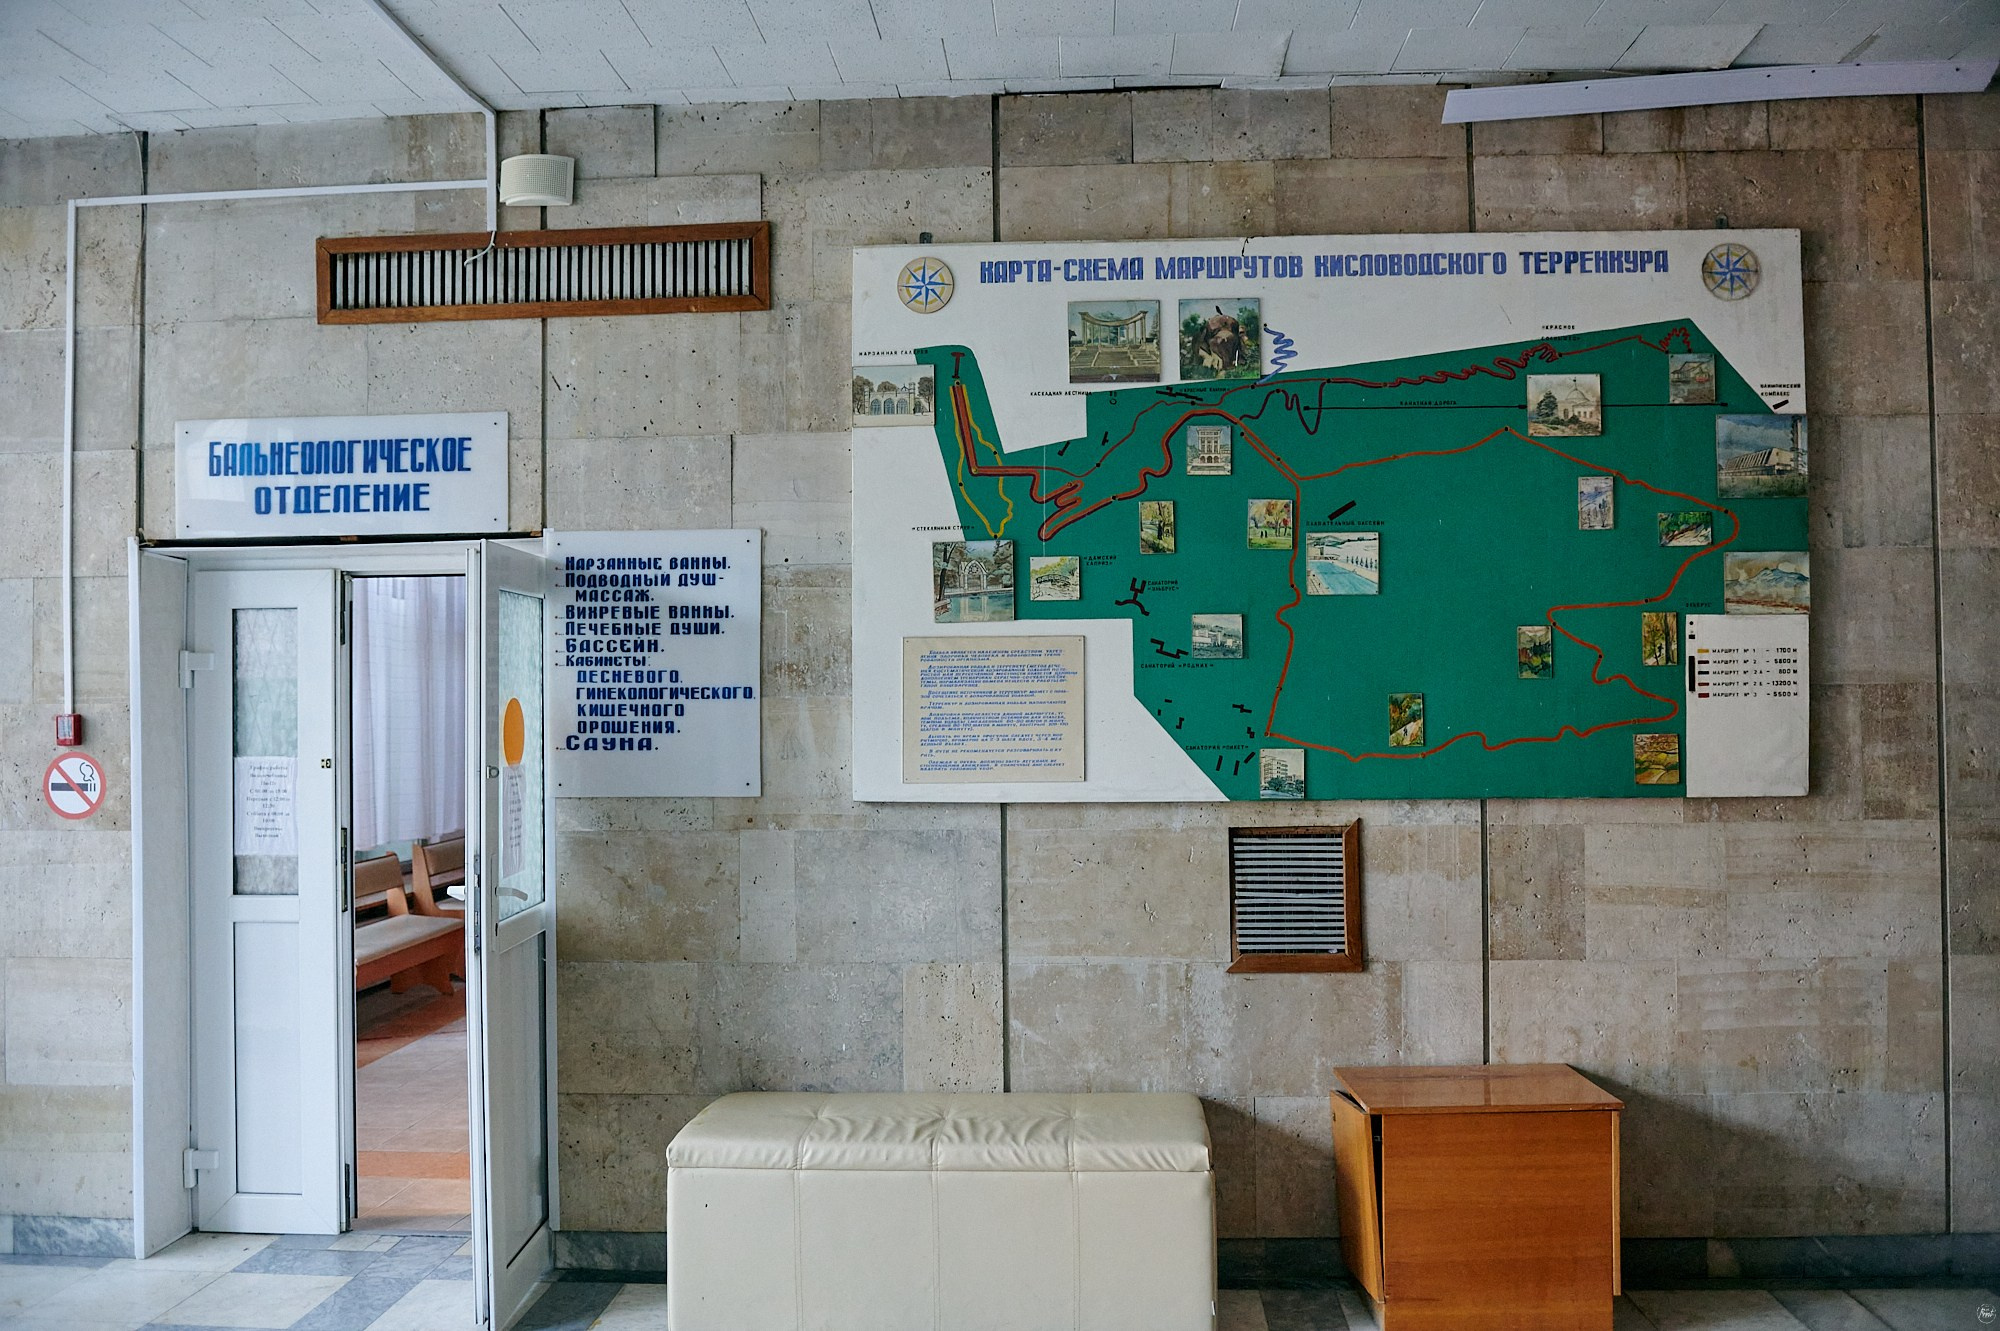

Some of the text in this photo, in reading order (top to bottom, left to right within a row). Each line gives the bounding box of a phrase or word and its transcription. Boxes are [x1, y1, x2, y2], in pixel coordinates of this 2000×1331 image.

[980, 249, 1669, 284] КАРТА-СХЕМА МАРШРУТОВ КИСЛОВОДСКОГО ТЕРРЕНКУРА
[208, 437, 473, 477] БАЛЬНЕОЛОГИЧЕСКОЕ
[254, 483, 431, 515] ОТДЕЛЕНИЕ
[566, 556, 731, 571] НАРЗАННЫЕ ВАННЫ.
[566, 572, 725, 588] ПОДВОДНЫЙ ДУШ-
[576, 589, 655, 602] МАССАЖ.
[566, 605, 735, 619] ВИХРЕВЫЕ ВАННЫ.
[566, 622, 725, 636] ЛЕЧЕБНЫЕ ДУШИ.
[566, 637, 665, 653] БАССЕЙН.
[577, 704, 685, 717] КИШЕЧНОГО
[577, 720, 681, 734] ОРОШЕНИЯ.
[566, 735, 659, 751] САУНА.
